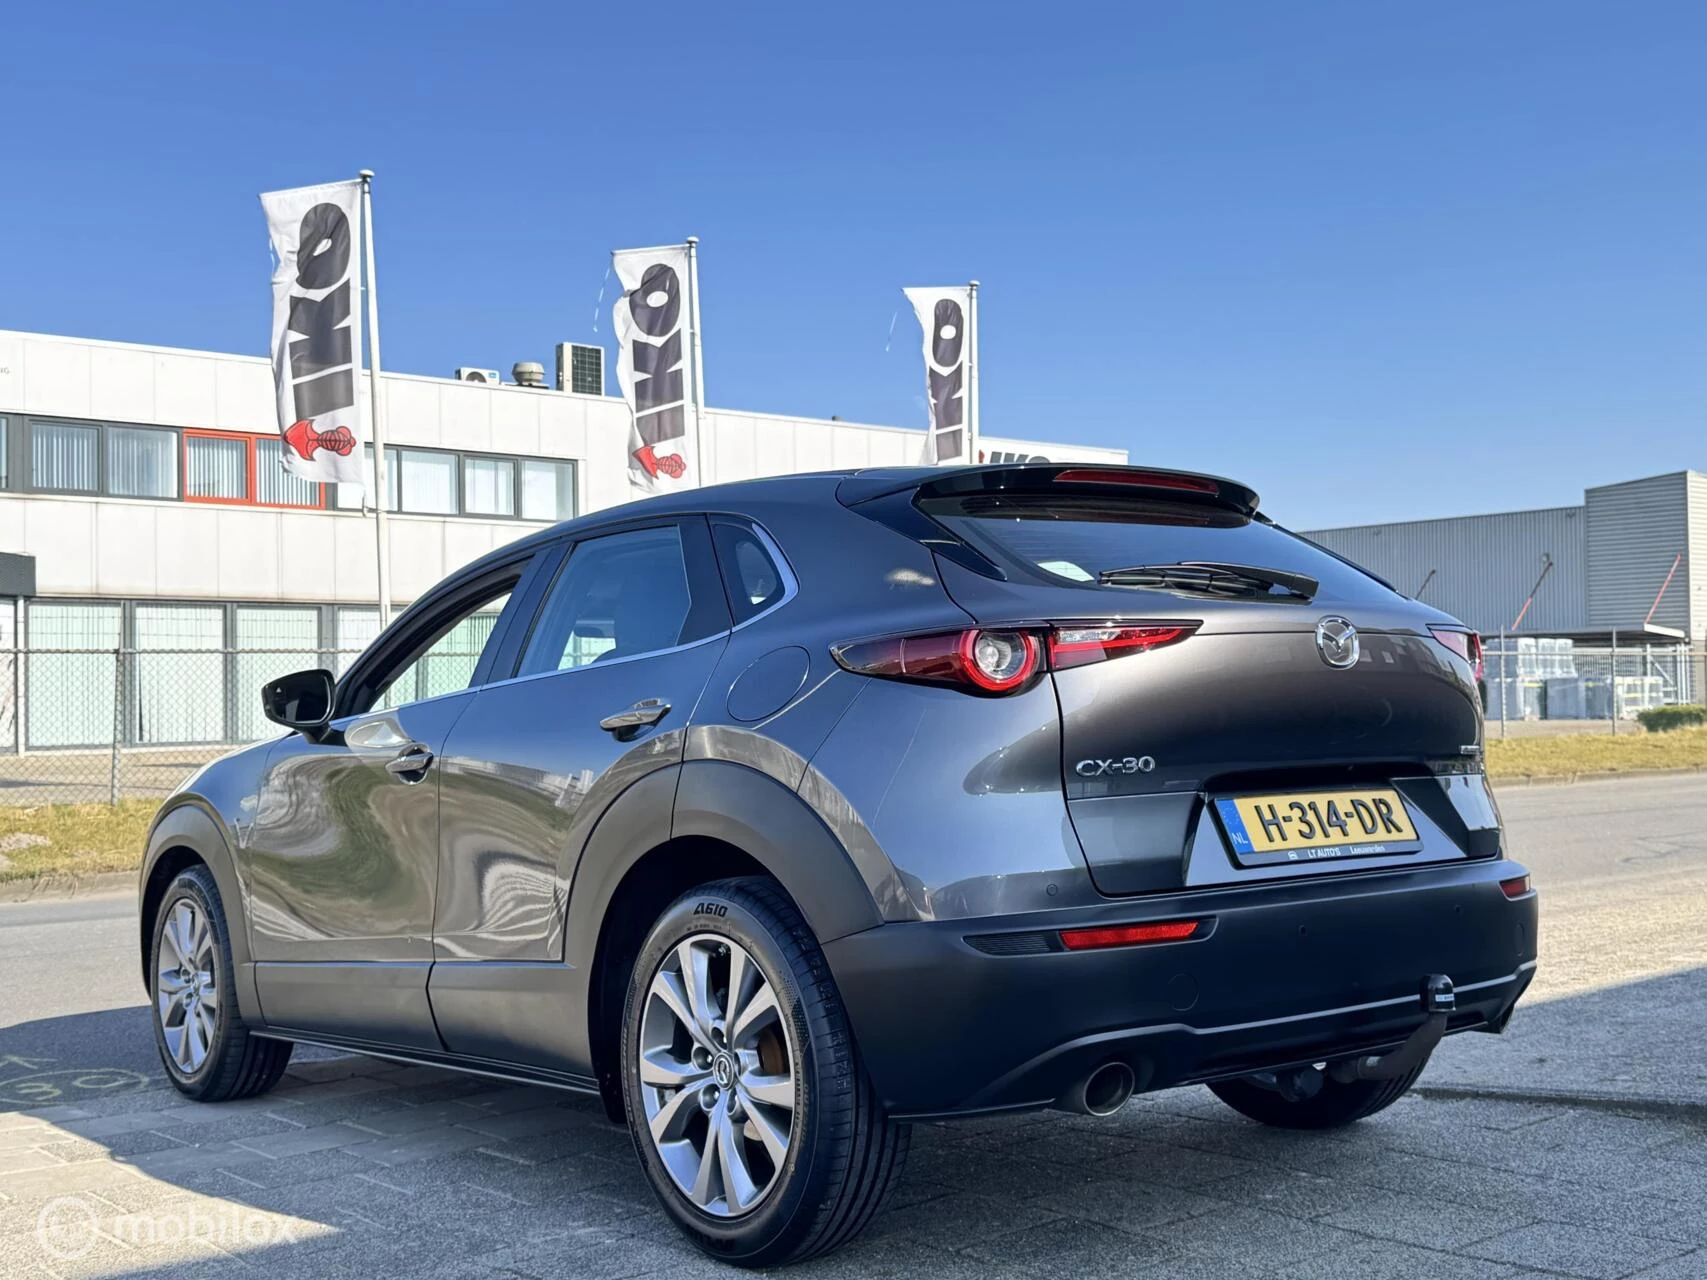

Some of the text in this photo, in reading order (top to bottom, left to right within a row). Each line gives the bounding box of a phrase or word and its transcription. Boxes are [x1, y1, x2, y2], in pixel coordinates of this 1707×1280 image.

[288, 202, 354, 418] IKO
[628, 263, 685, 444] IKO
[928, 298, 964, 462] IKO
[1076, 756, 1155, 776] CX-30
[1232, 832, 1248, 845] NL
[1254, 798, 1403, 843] H-314-DR
